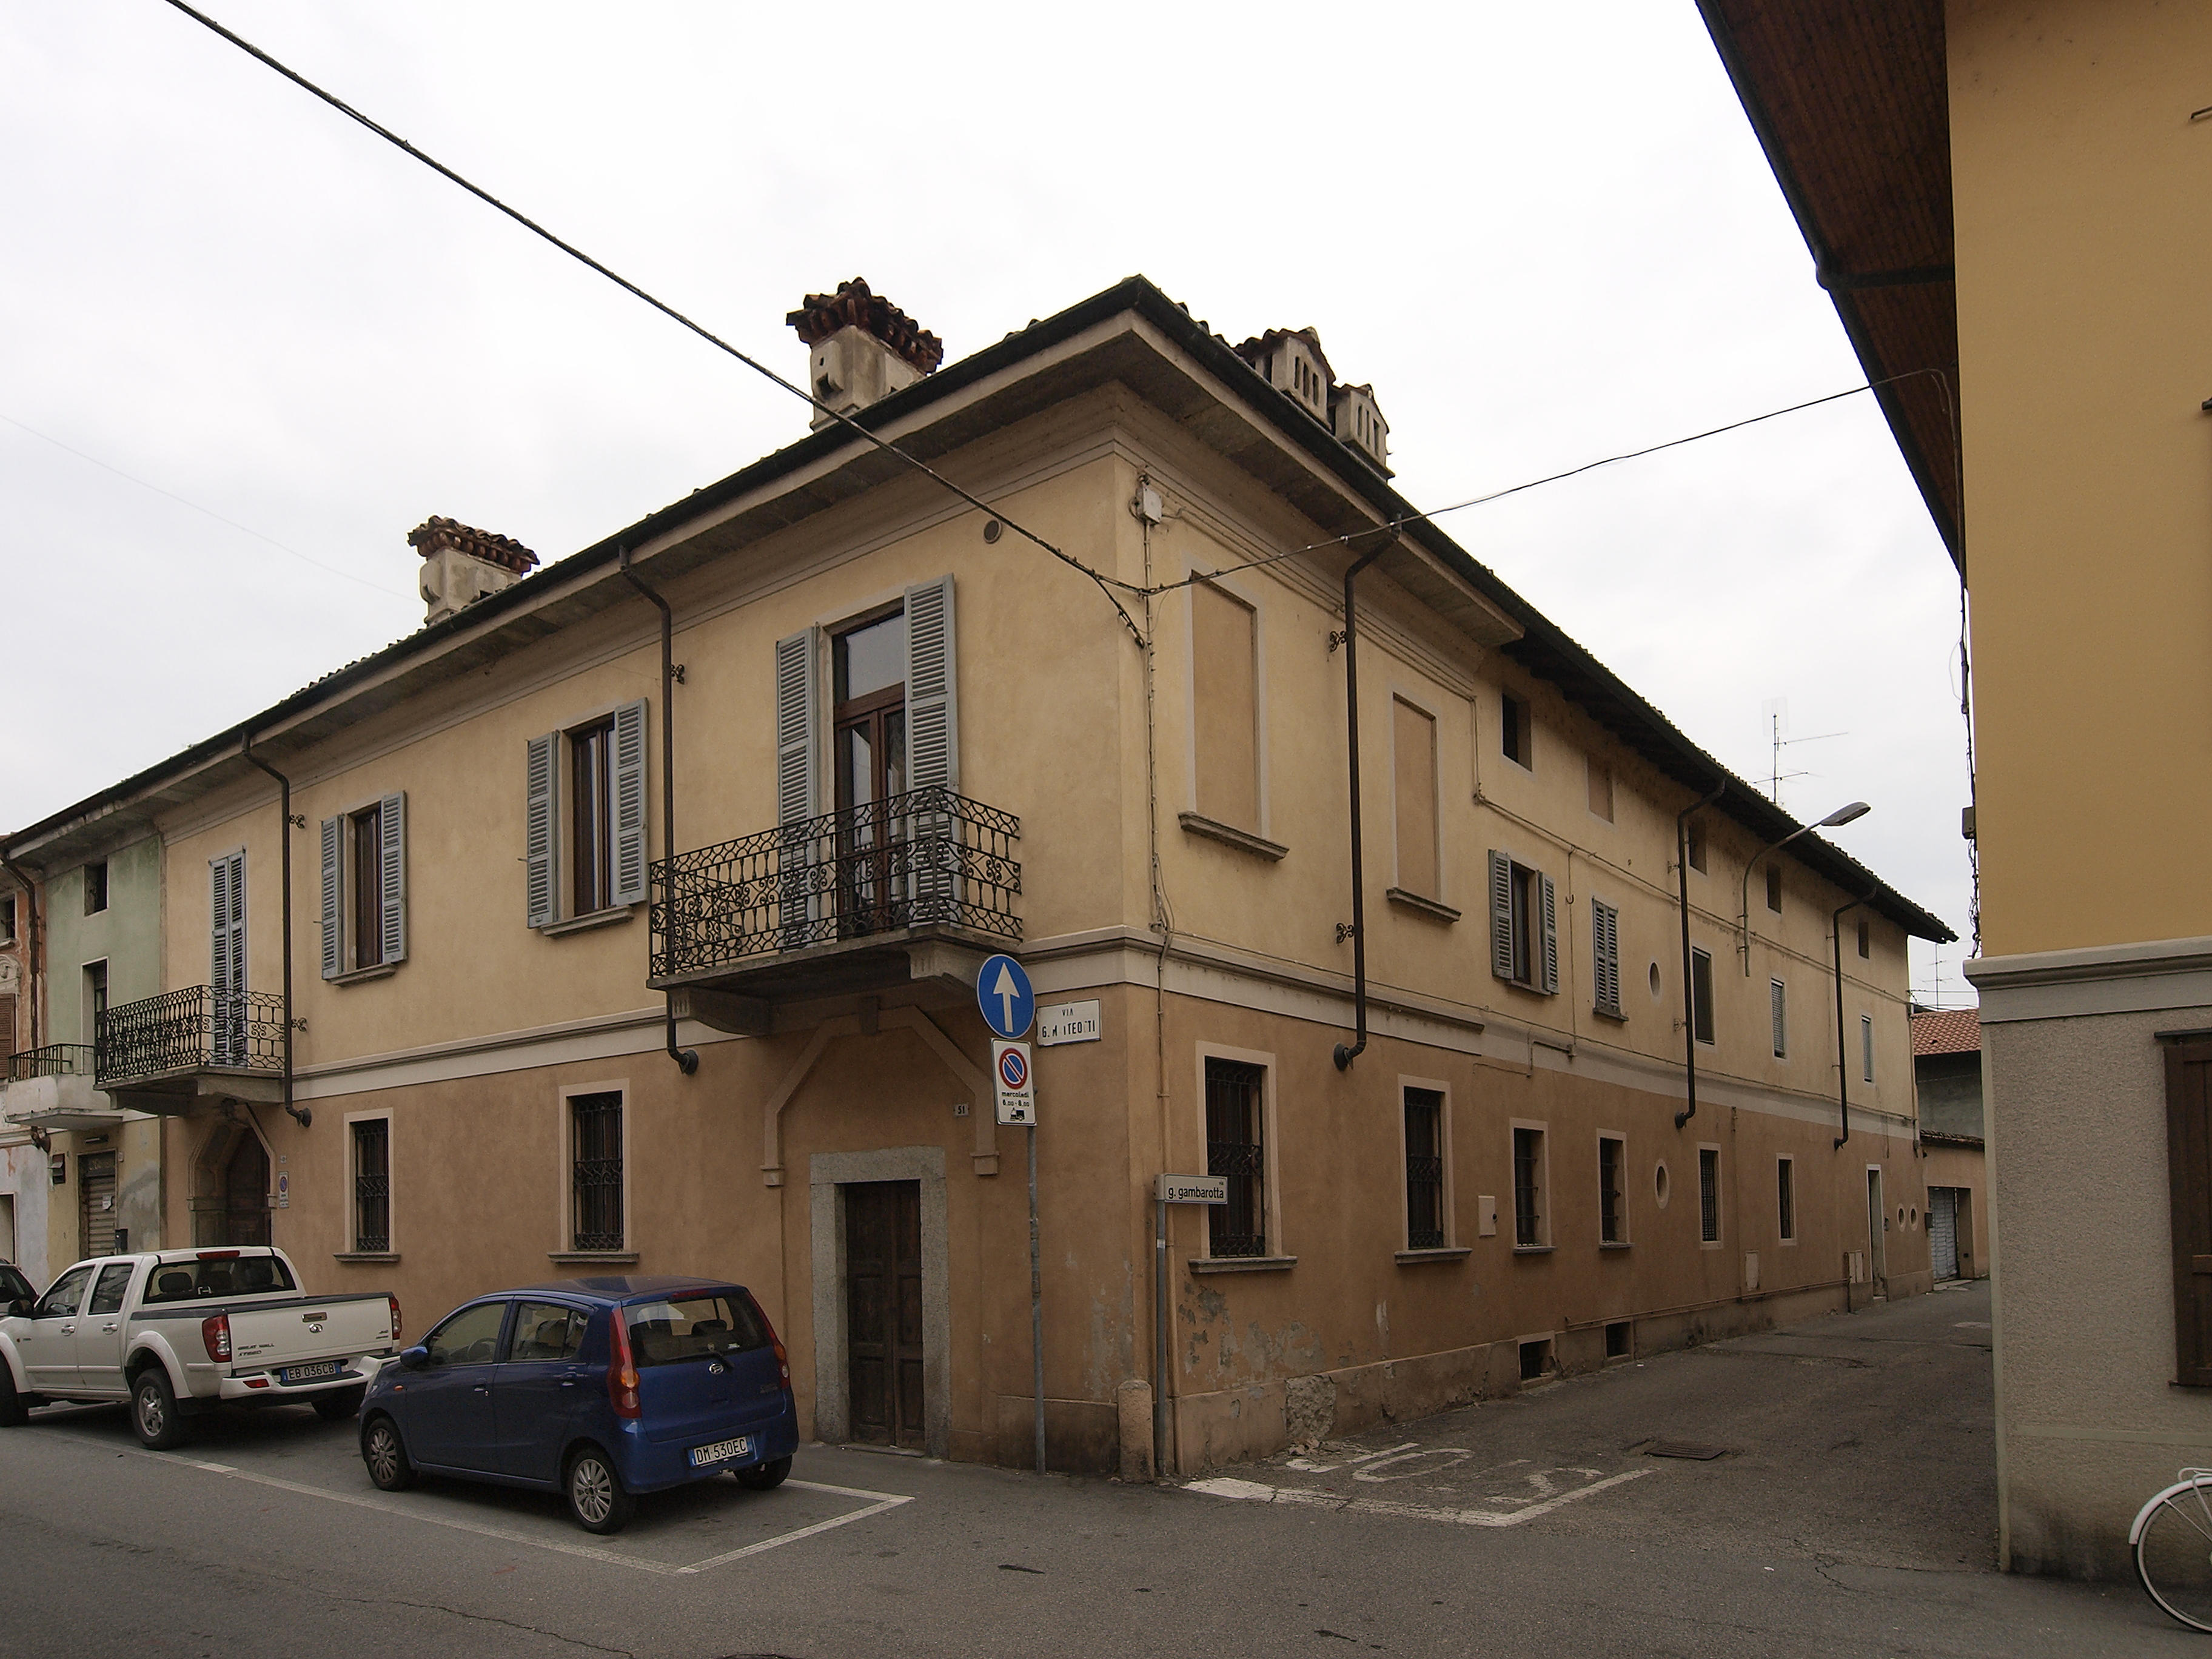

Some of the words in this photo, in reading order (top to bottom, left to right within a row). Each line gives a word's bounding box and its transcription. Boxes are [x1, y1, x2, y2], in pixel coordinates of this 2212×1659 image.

[1062, 1008, 1074, 1016] VIA
[1042, 1026, 1050, 1037] G.
[1052, 1020, 1095, 1037] MTTEOTI
[958, 1105, 965, 1114] 51
[1168, 1187, 1176, 1199] g.
[1178, 1186, 1224, 1199] gambarotta
[288, 1368, 301, 1379] EB
[304, 1363, 335, 1377] 036CB
[695, 1447, 711, 1463] DM
[713, 1438, 746, 1458] 530EC
